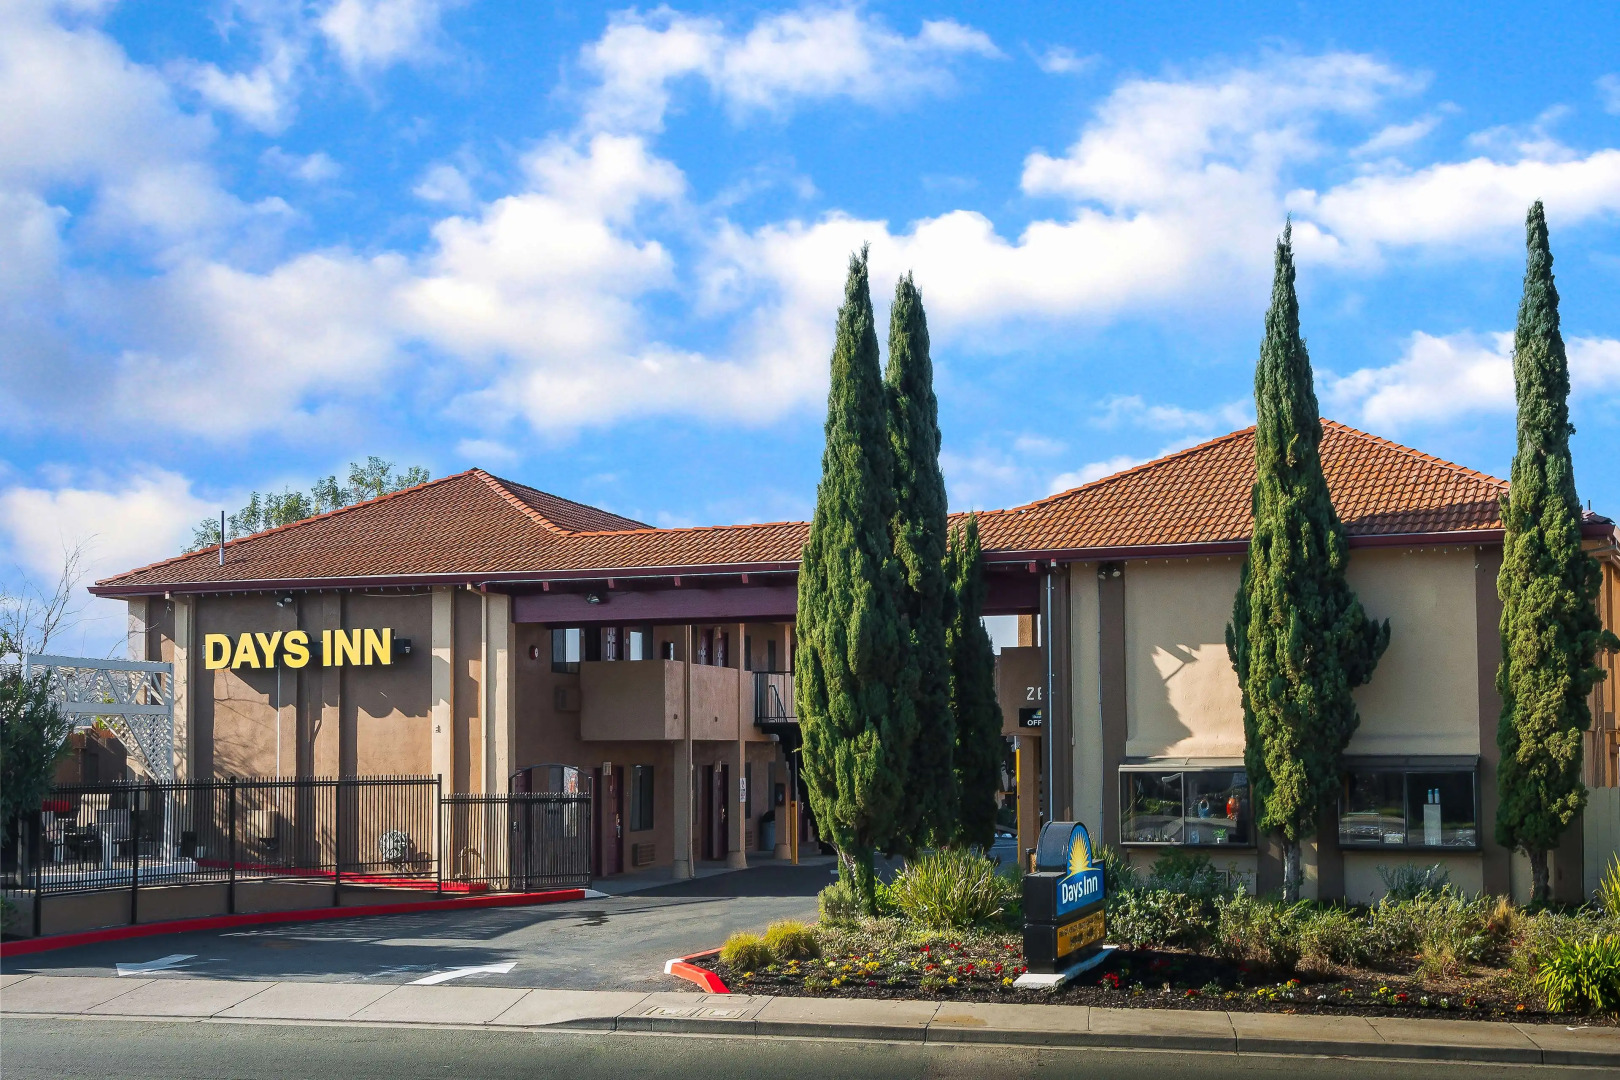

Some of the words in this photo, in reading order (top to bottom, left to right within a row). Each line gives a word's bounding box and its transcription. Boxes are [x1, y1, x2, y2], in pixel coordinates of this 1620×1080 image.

[204, 629, 310, 670] DAYS
[321, 627, 392, 668] INN
[1061, 881, 1083, 905] Days
[1083, 875, 1098, 896] Inn
